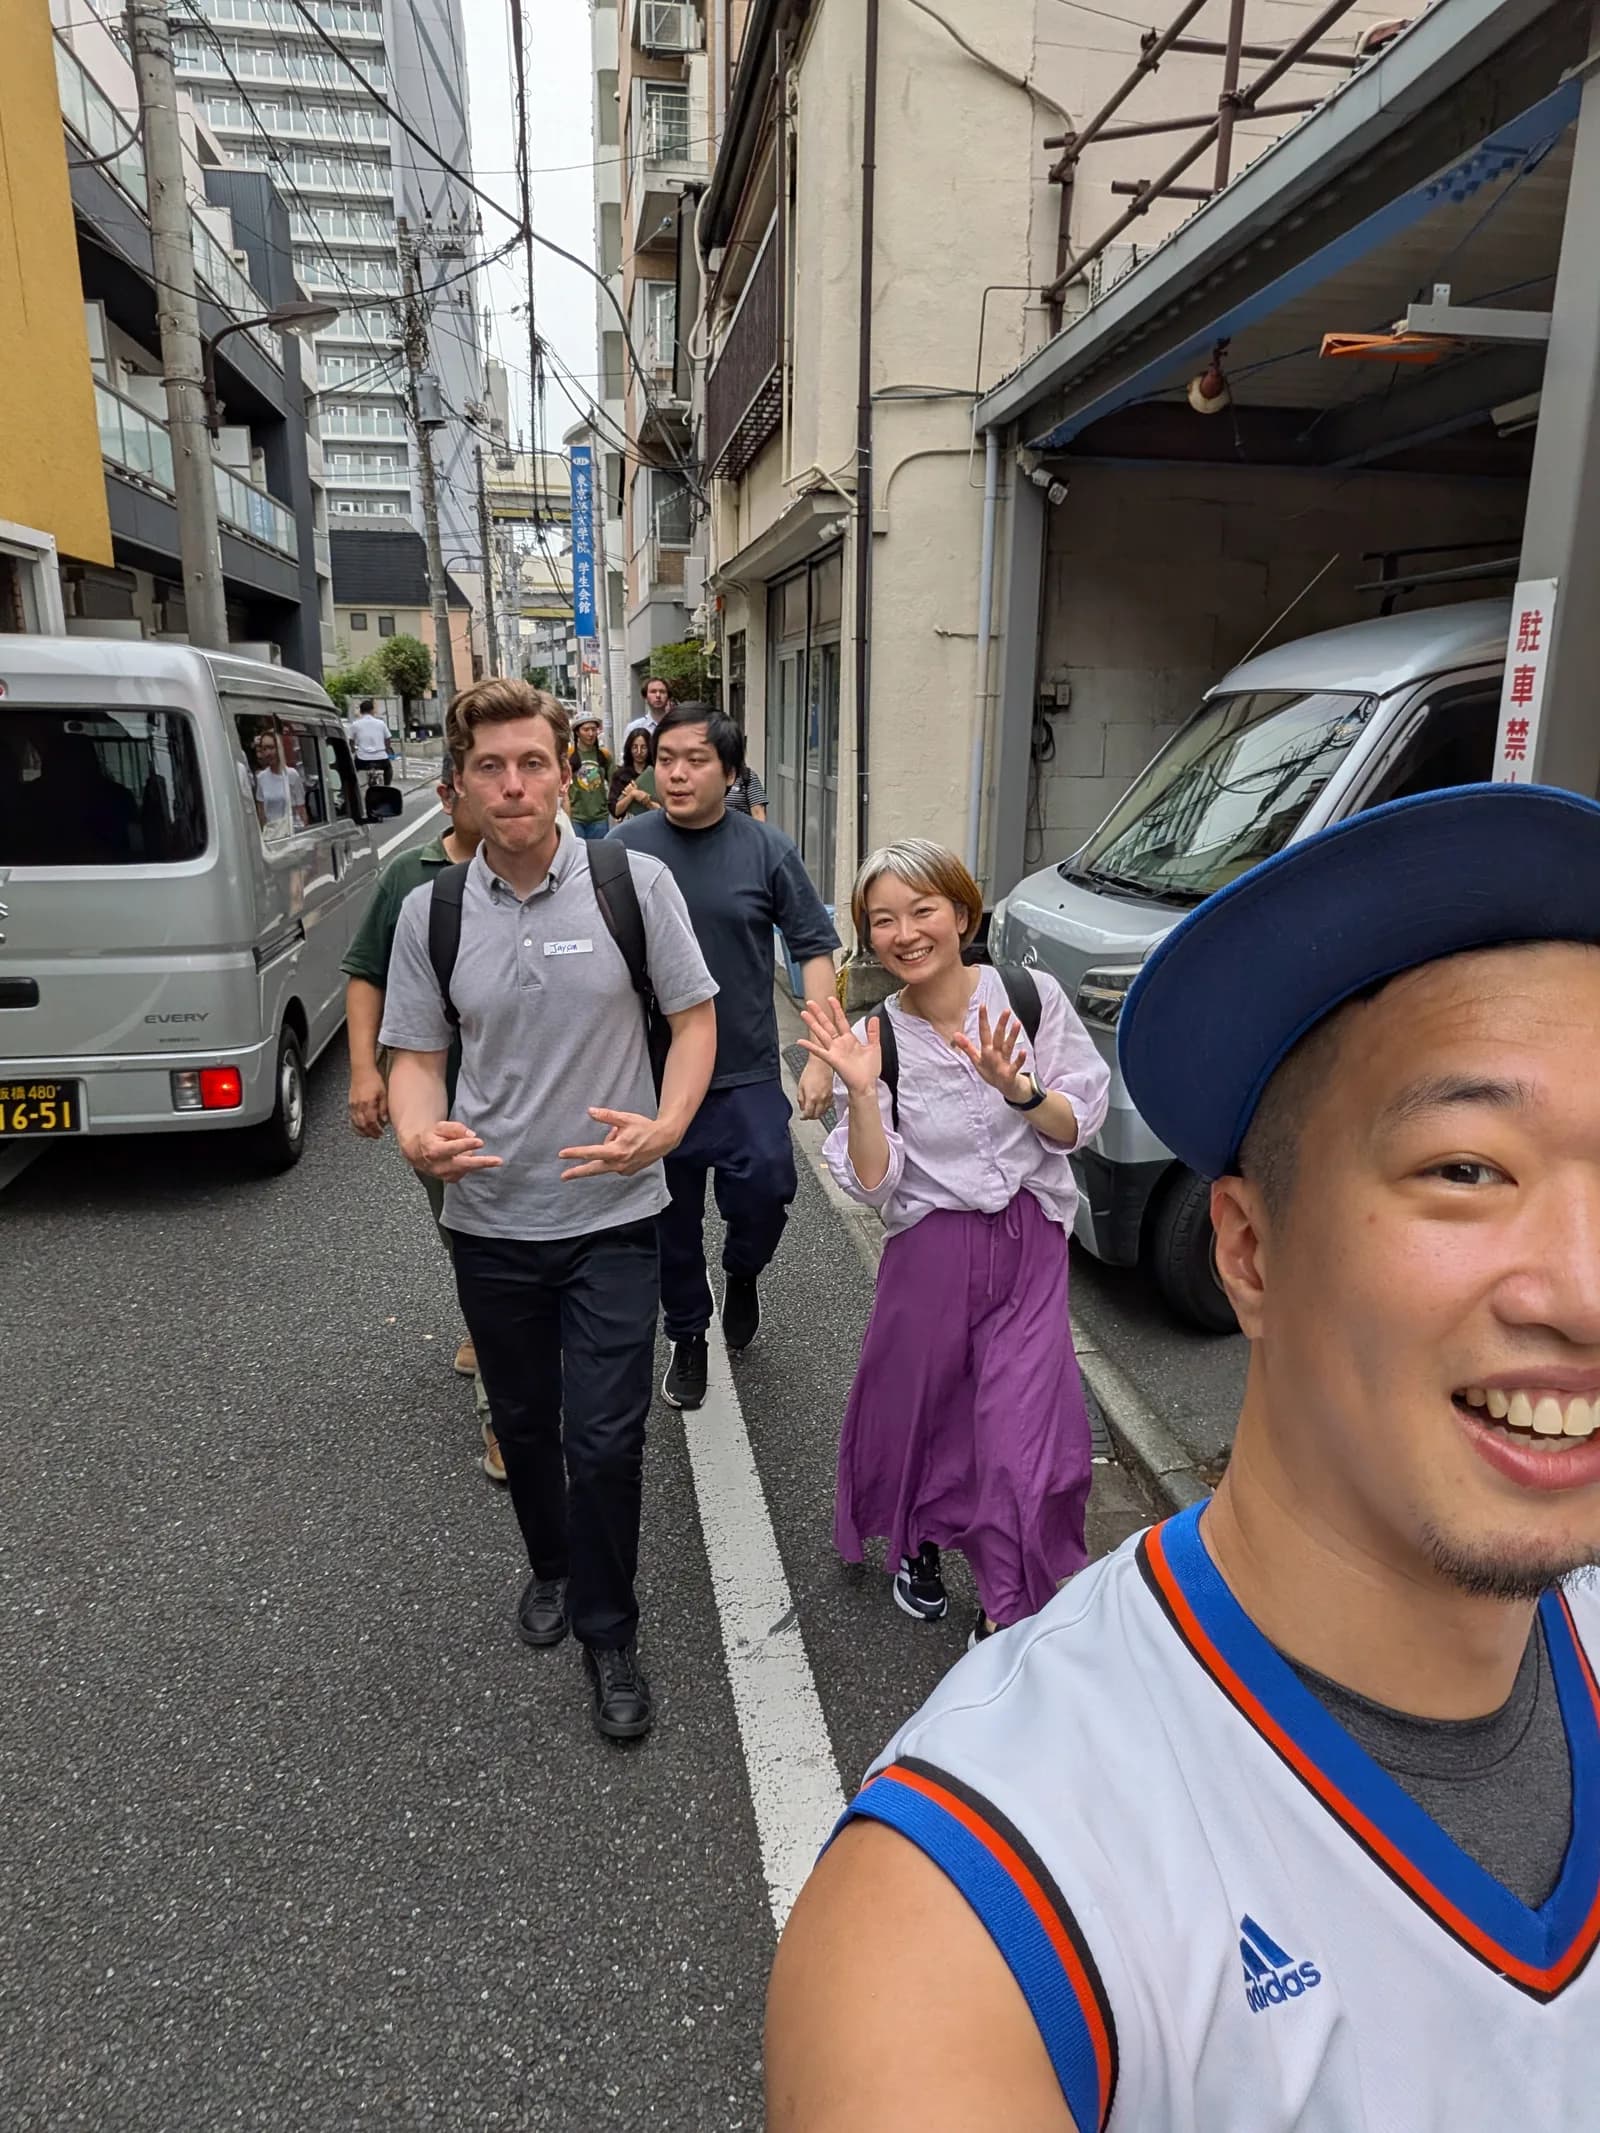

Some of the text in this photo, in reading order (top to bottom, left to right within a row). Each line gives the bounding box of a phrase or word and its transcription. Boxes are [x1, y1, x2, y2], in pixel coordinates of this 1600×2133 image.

[577, 561, 591, 614] 学生会館
[144, 1013, 209, 1024] EVERY
[28, 1085, 56, 1099] 480
